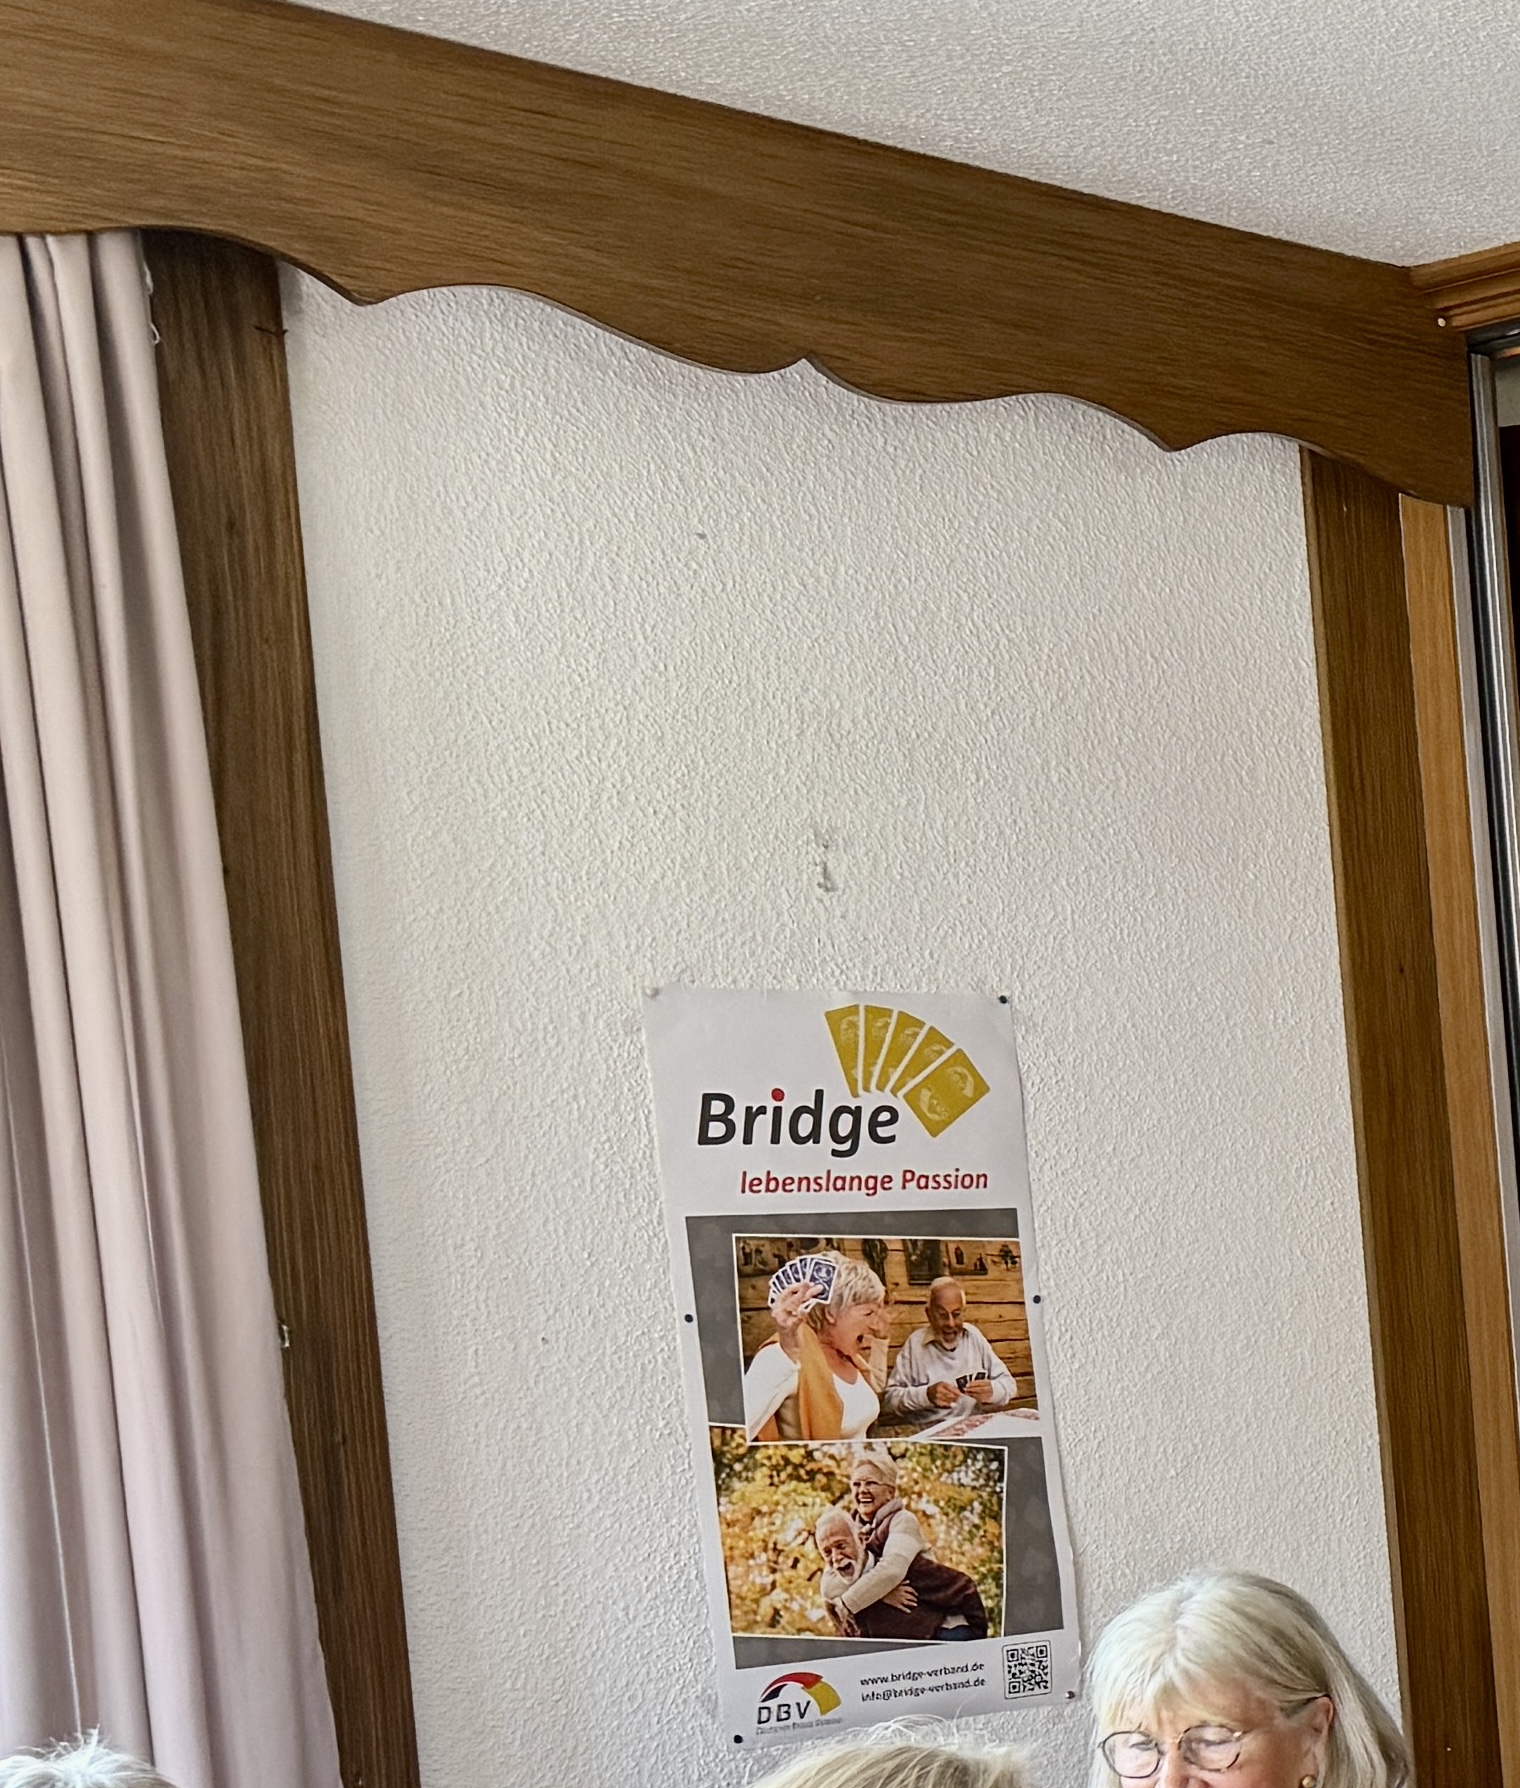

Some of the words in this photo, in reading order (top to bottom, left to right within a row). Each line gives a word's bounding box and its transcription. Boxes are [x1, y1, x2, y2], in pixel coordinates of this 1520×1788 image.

[697, 1087, 900, 1158] Bridge
[740, 1169, 894, 1197] lebenslange
[901, 1167, 989, 1191] Passion
[757, 1700, 811, 1725] DBV
